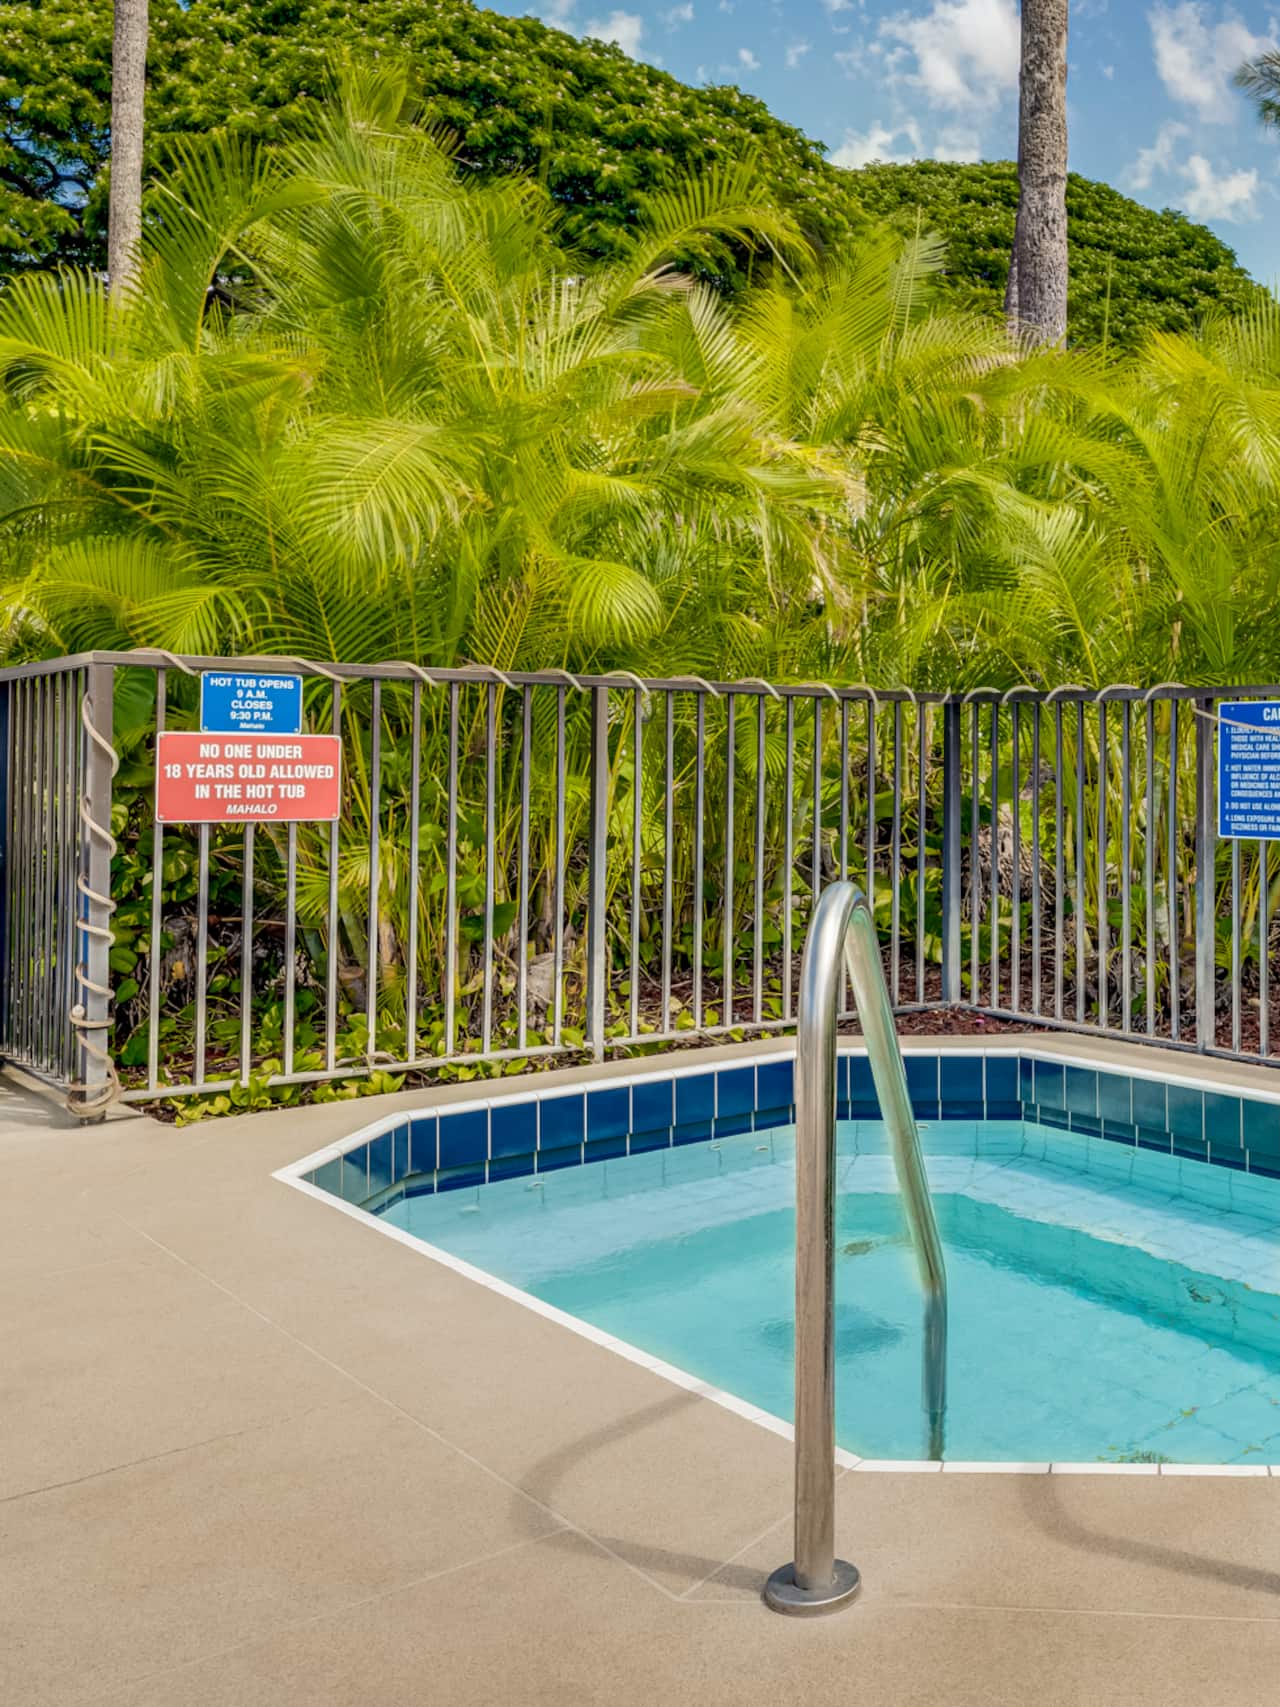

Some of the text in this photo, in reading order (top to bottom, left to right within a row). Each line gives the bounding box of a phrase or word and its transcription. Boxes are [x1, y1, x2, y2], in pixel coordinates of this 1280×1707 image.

[210, 678, 294, 689] HOT TUB OPENS
[237, 690, 267, 699] 9 A.M.
[231, 700, 272, 710] CLOSES
[230, 711, 272, 720] 9:30 P.M.
[200, 744, 302, 758] NO ONE UNDER
[1261, 752, 1280, 760] BEFORE
[164, 765, 334, 779] 18 YEARS OLD ALLOWED
[195, 785, 305, 798] IN THE HOT TUB
[226, 804, 277, 814] MAHALO
[1231, 802, 1239, 810] DO
[1246, 815, 1275, 823] EXPOSURE
